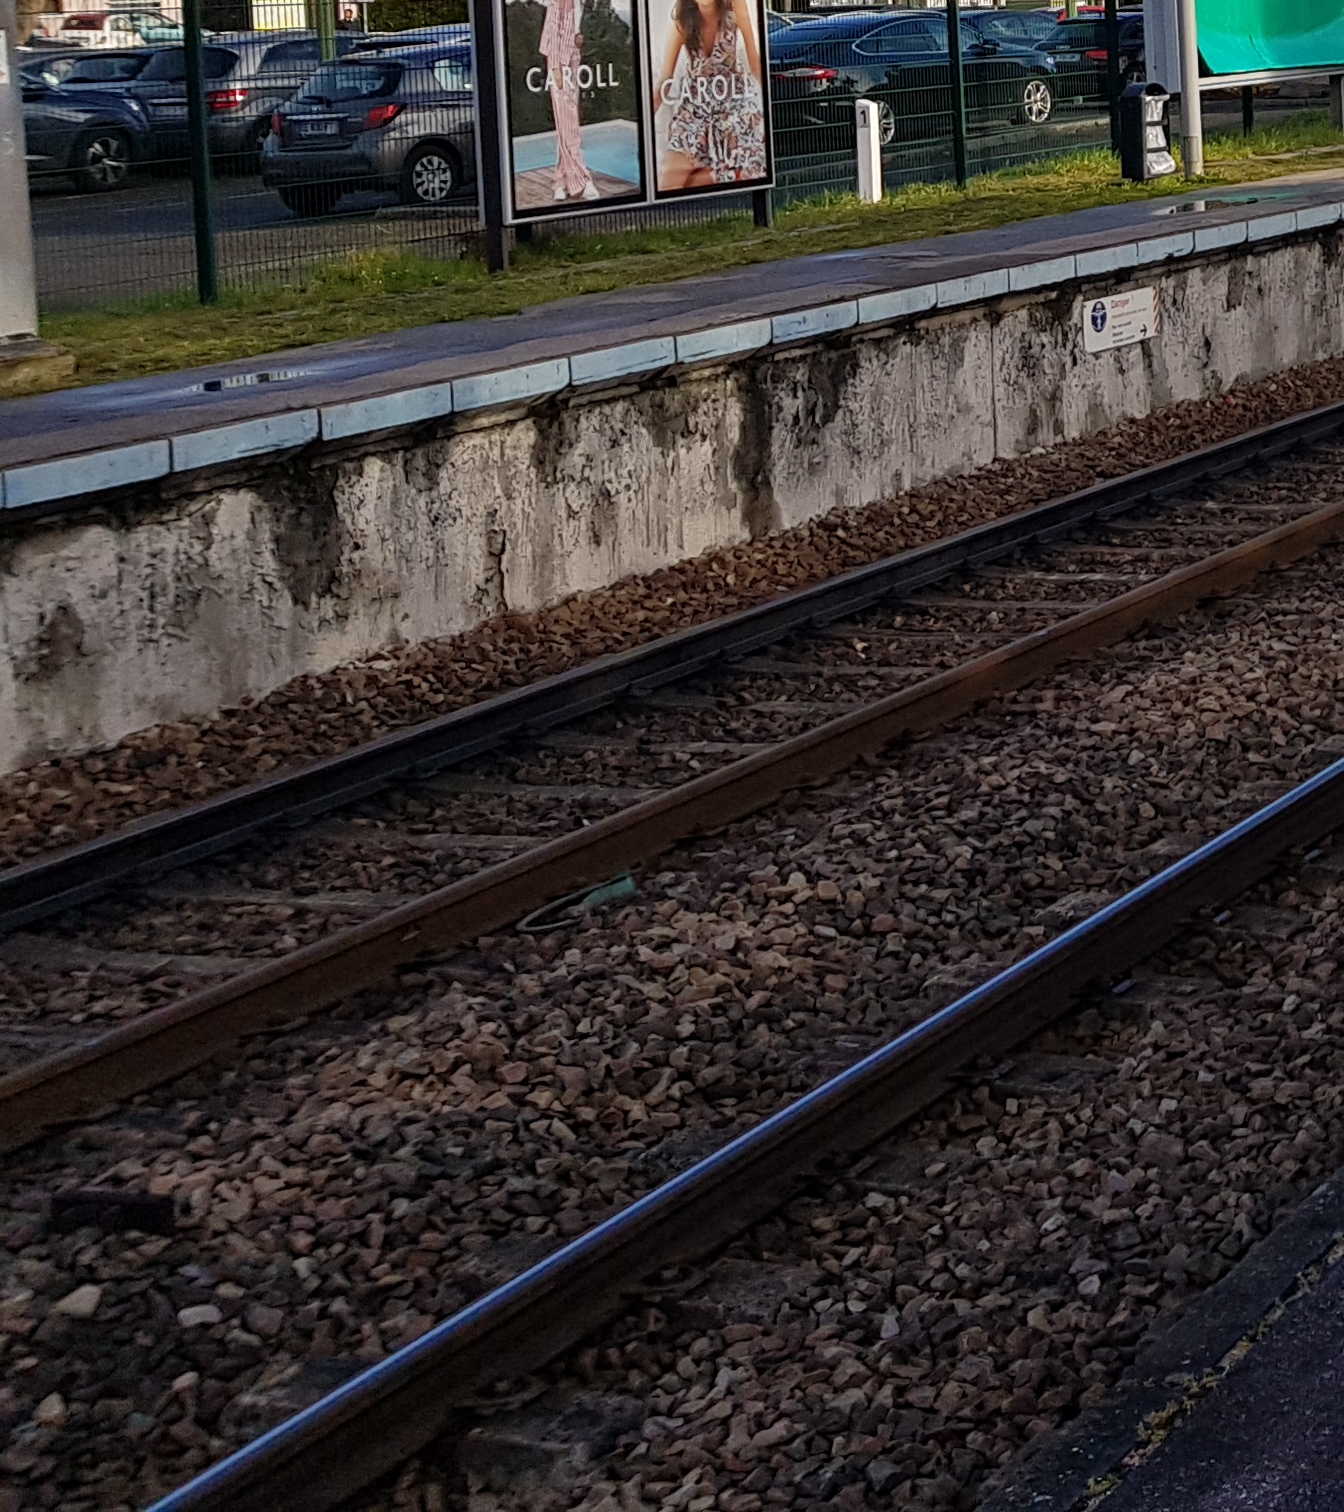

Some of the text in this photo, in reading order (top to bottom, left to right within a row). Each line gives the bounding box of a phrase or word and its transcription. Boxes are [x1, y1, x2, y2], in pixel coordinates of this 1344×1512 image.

[525, 62, 620, 93] CAROLL
[660, 72, 759, 106] CAROLL
[860, 109, 867, 125] 1
